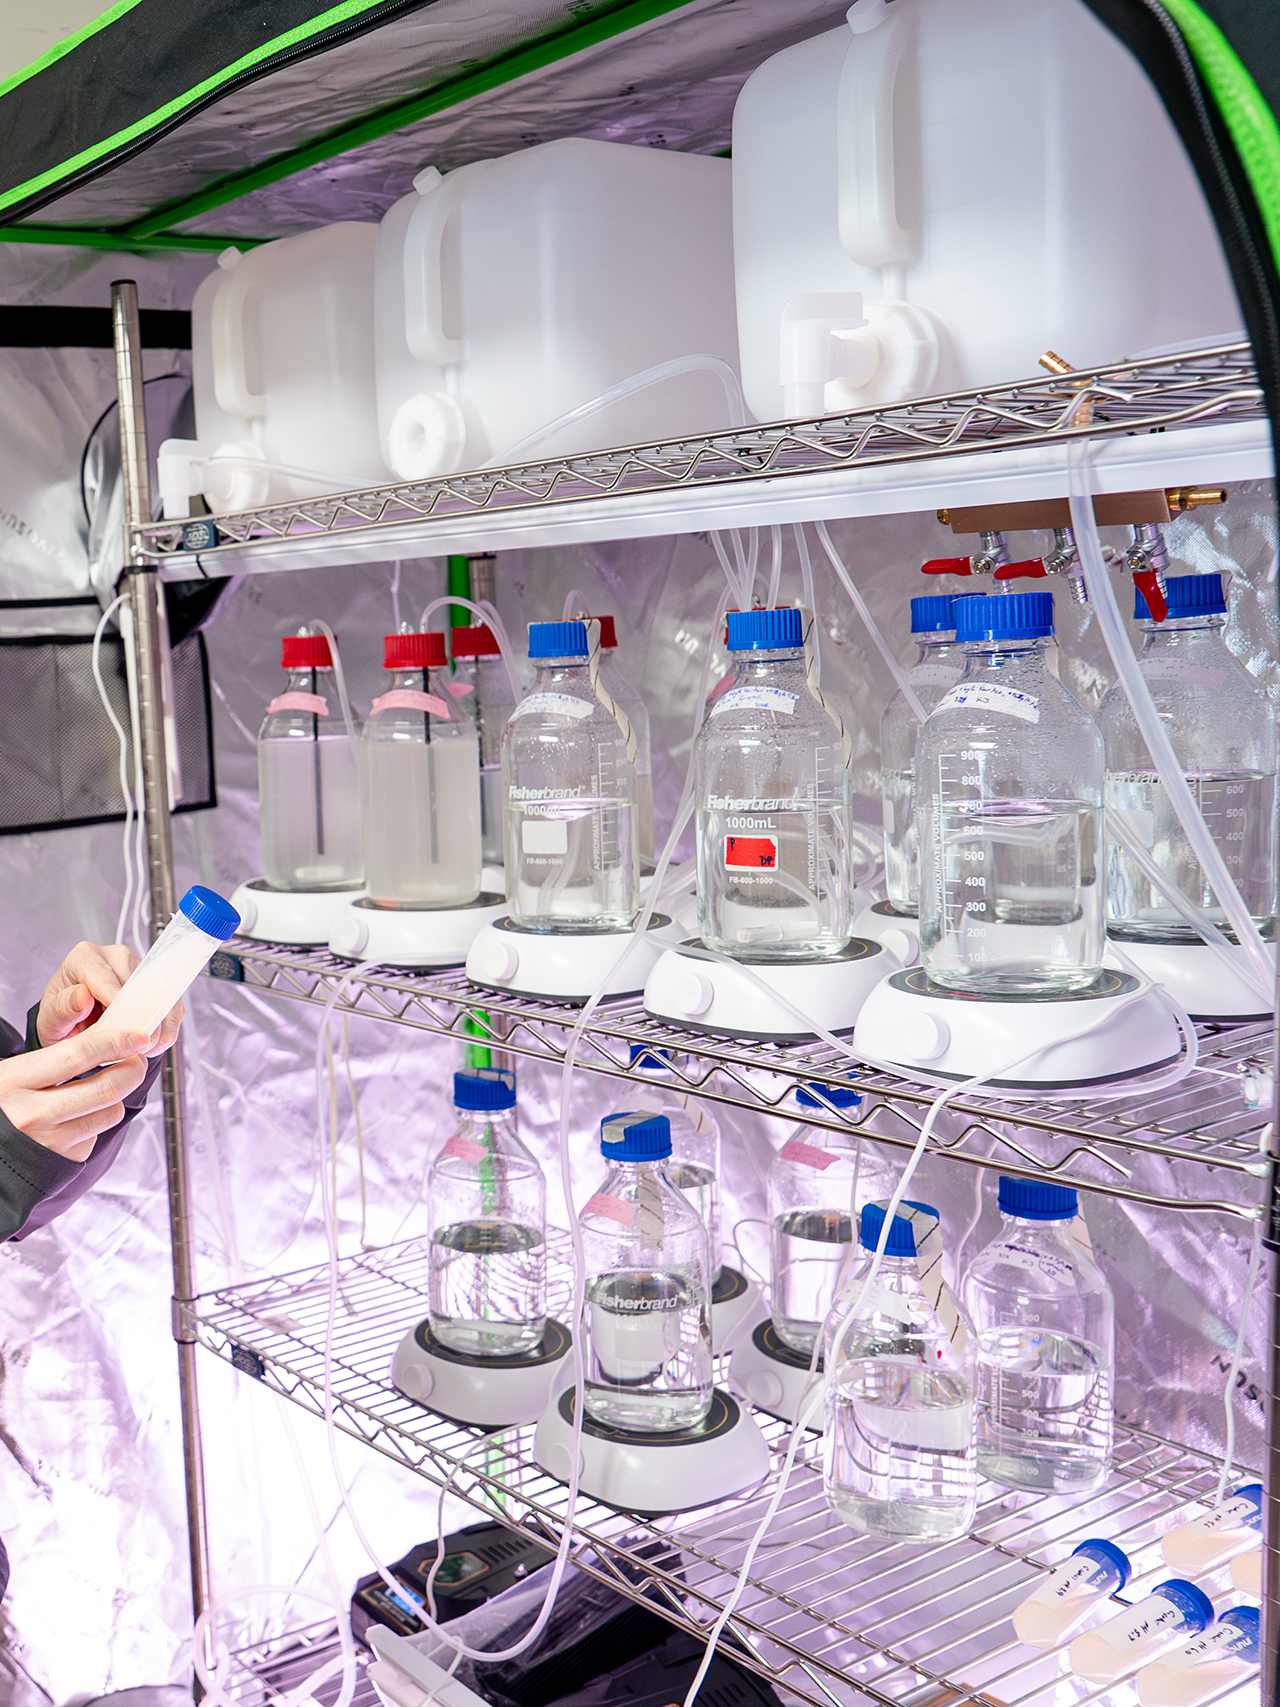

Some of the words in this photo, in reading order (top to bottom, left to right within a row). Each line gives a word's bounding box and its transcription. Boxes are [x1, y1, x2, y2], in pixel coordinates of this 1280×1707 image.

[961, 776, 981, 786] 800
[1225, 785, 1244, 794] 600
[931, 793, 940, 841] VOLUMES
[1225, 808, 1244, 817] 500
[725, 817, 777, 829] 1000mL
[963, 825, 984, 836] 600
[1225, 832, 1244, 841] 400
[806, 828, 816, 891] APPROXIMATE
[964, 851, 985, 861] 500
[933, 843, 943, 913] APPROXIMATE
[965, 877, 986, 887] 400
[966, 902, 986, 912] 300
[966, 928, 987, 938] 200
